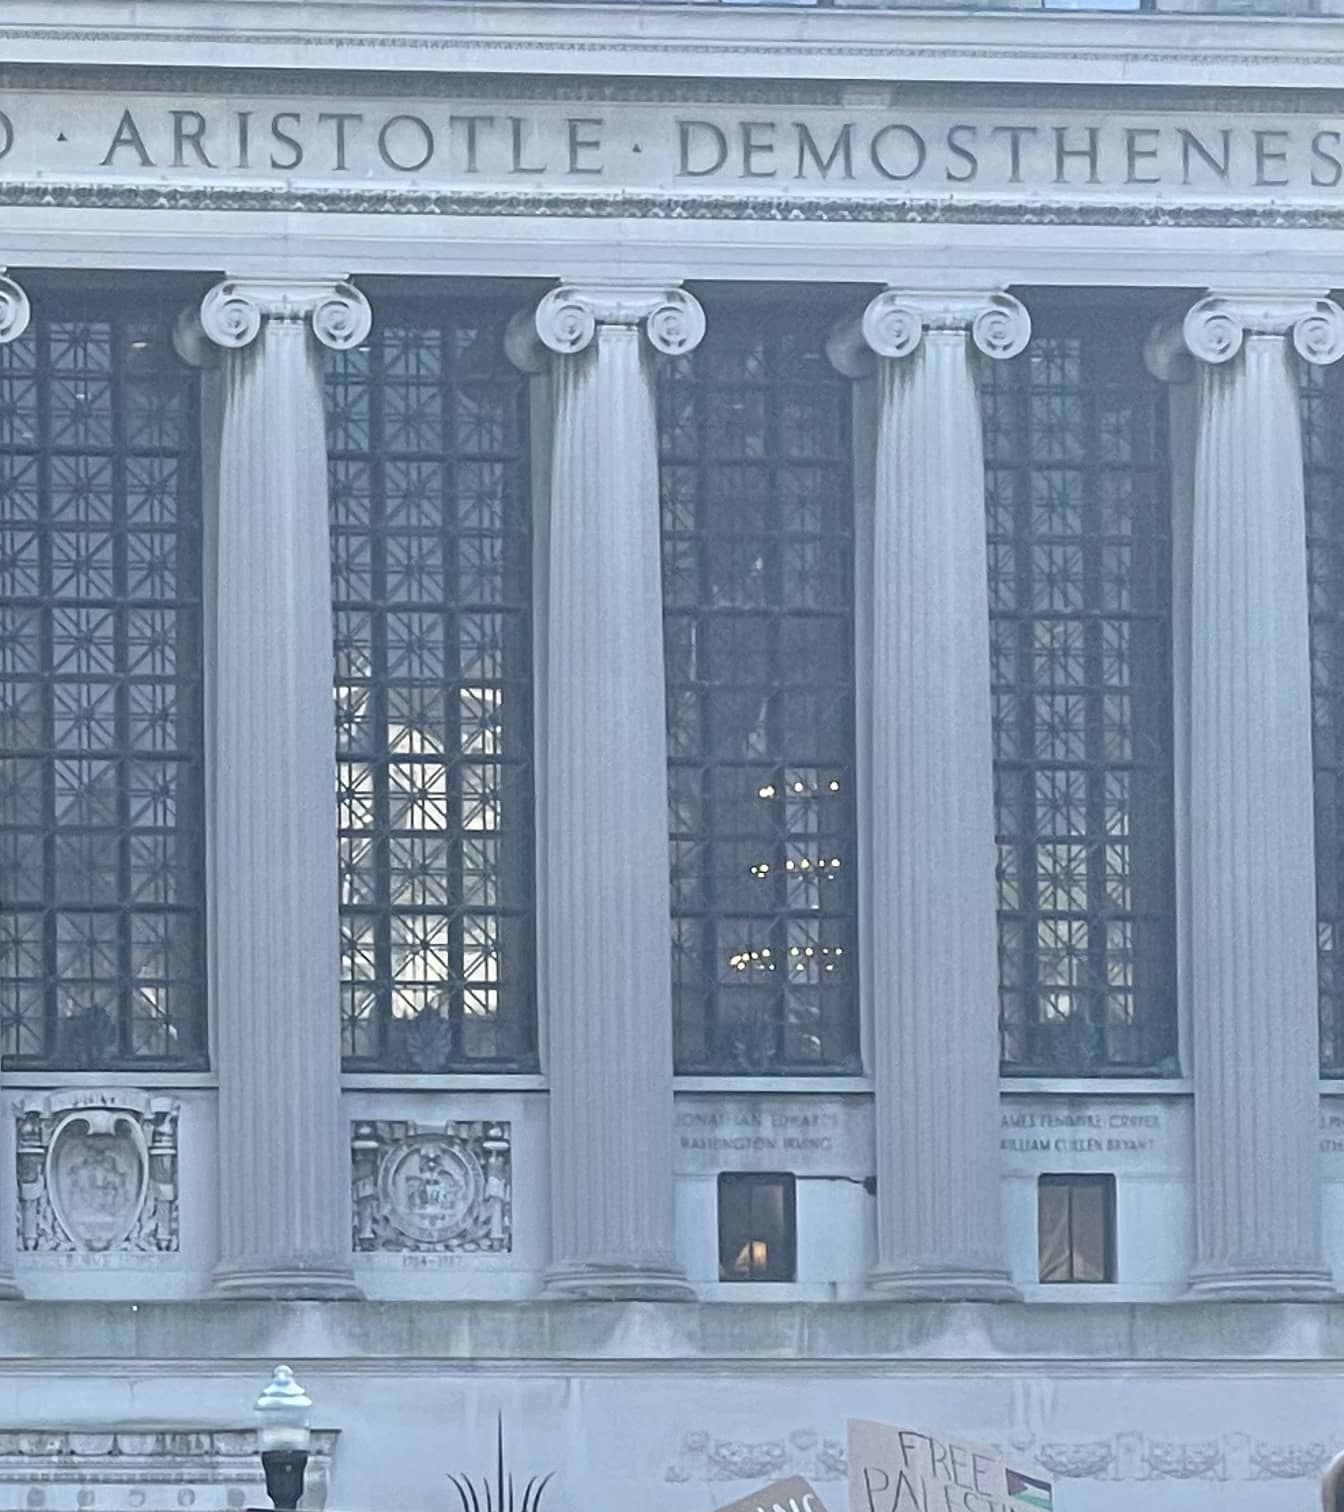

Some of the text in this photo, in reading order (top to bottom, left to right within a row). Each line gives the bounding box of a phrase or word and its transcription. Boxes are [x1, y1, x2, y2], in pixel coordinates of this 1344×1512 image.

[97, 108, 607, 177] ARISTOTLE
[674, 118, 1344, 188] DEMOSTHENES
[898, 1430, 993, 1497] FREE
